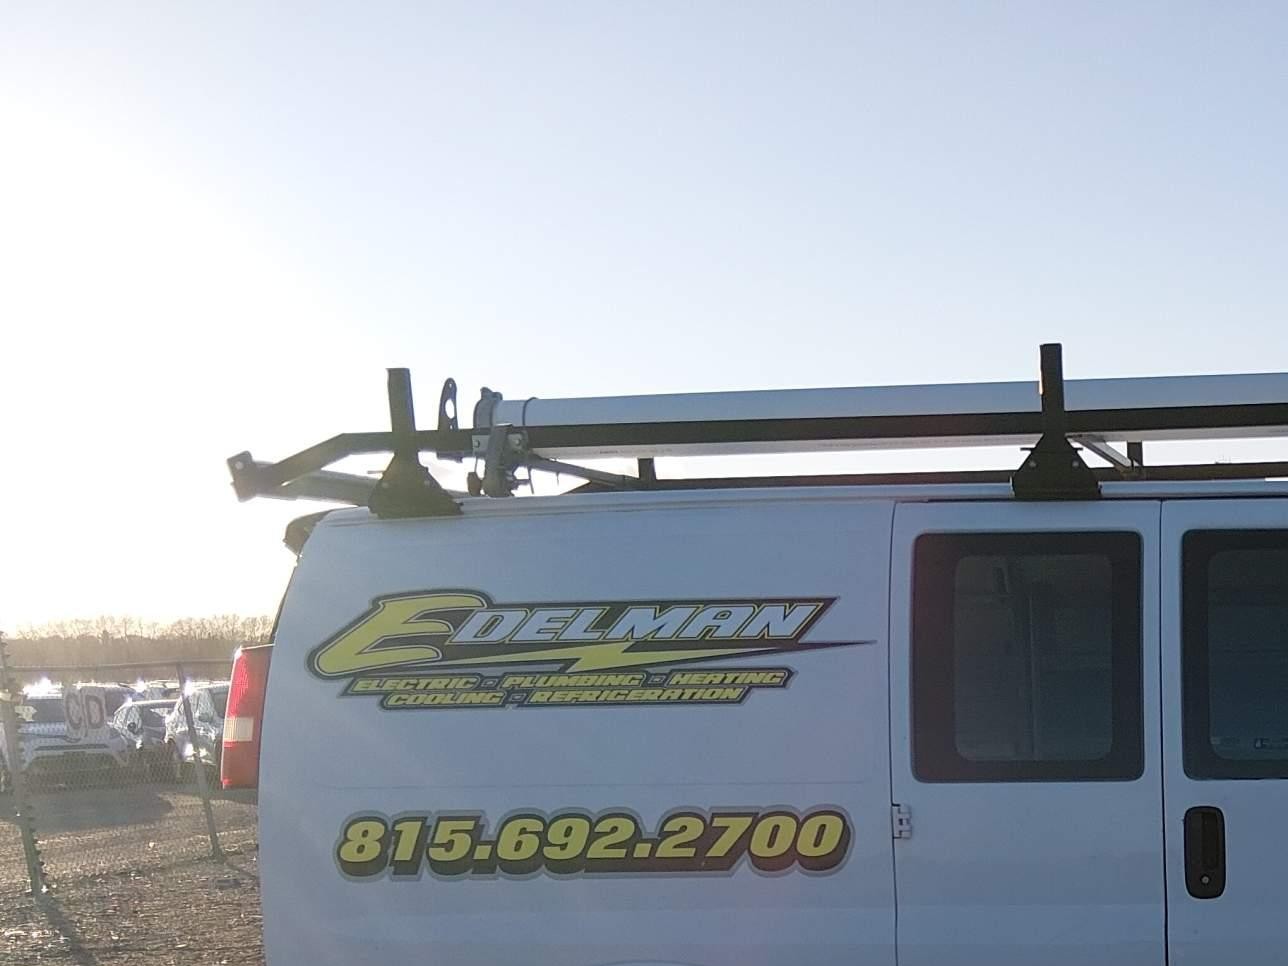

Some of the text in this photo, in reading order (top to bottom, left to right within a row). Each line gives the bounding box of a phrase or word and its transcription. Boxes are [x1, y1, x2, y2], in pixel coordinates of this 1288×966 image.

[316, 594, 825, 675] EDELMAN
[353, 671, 784, 692] ELECTRIC PLUMBING HEATING
[387, 686, 745, 707] COOLING REFRIGERATION
[339, 814, 847, 863] 815.692.2700
